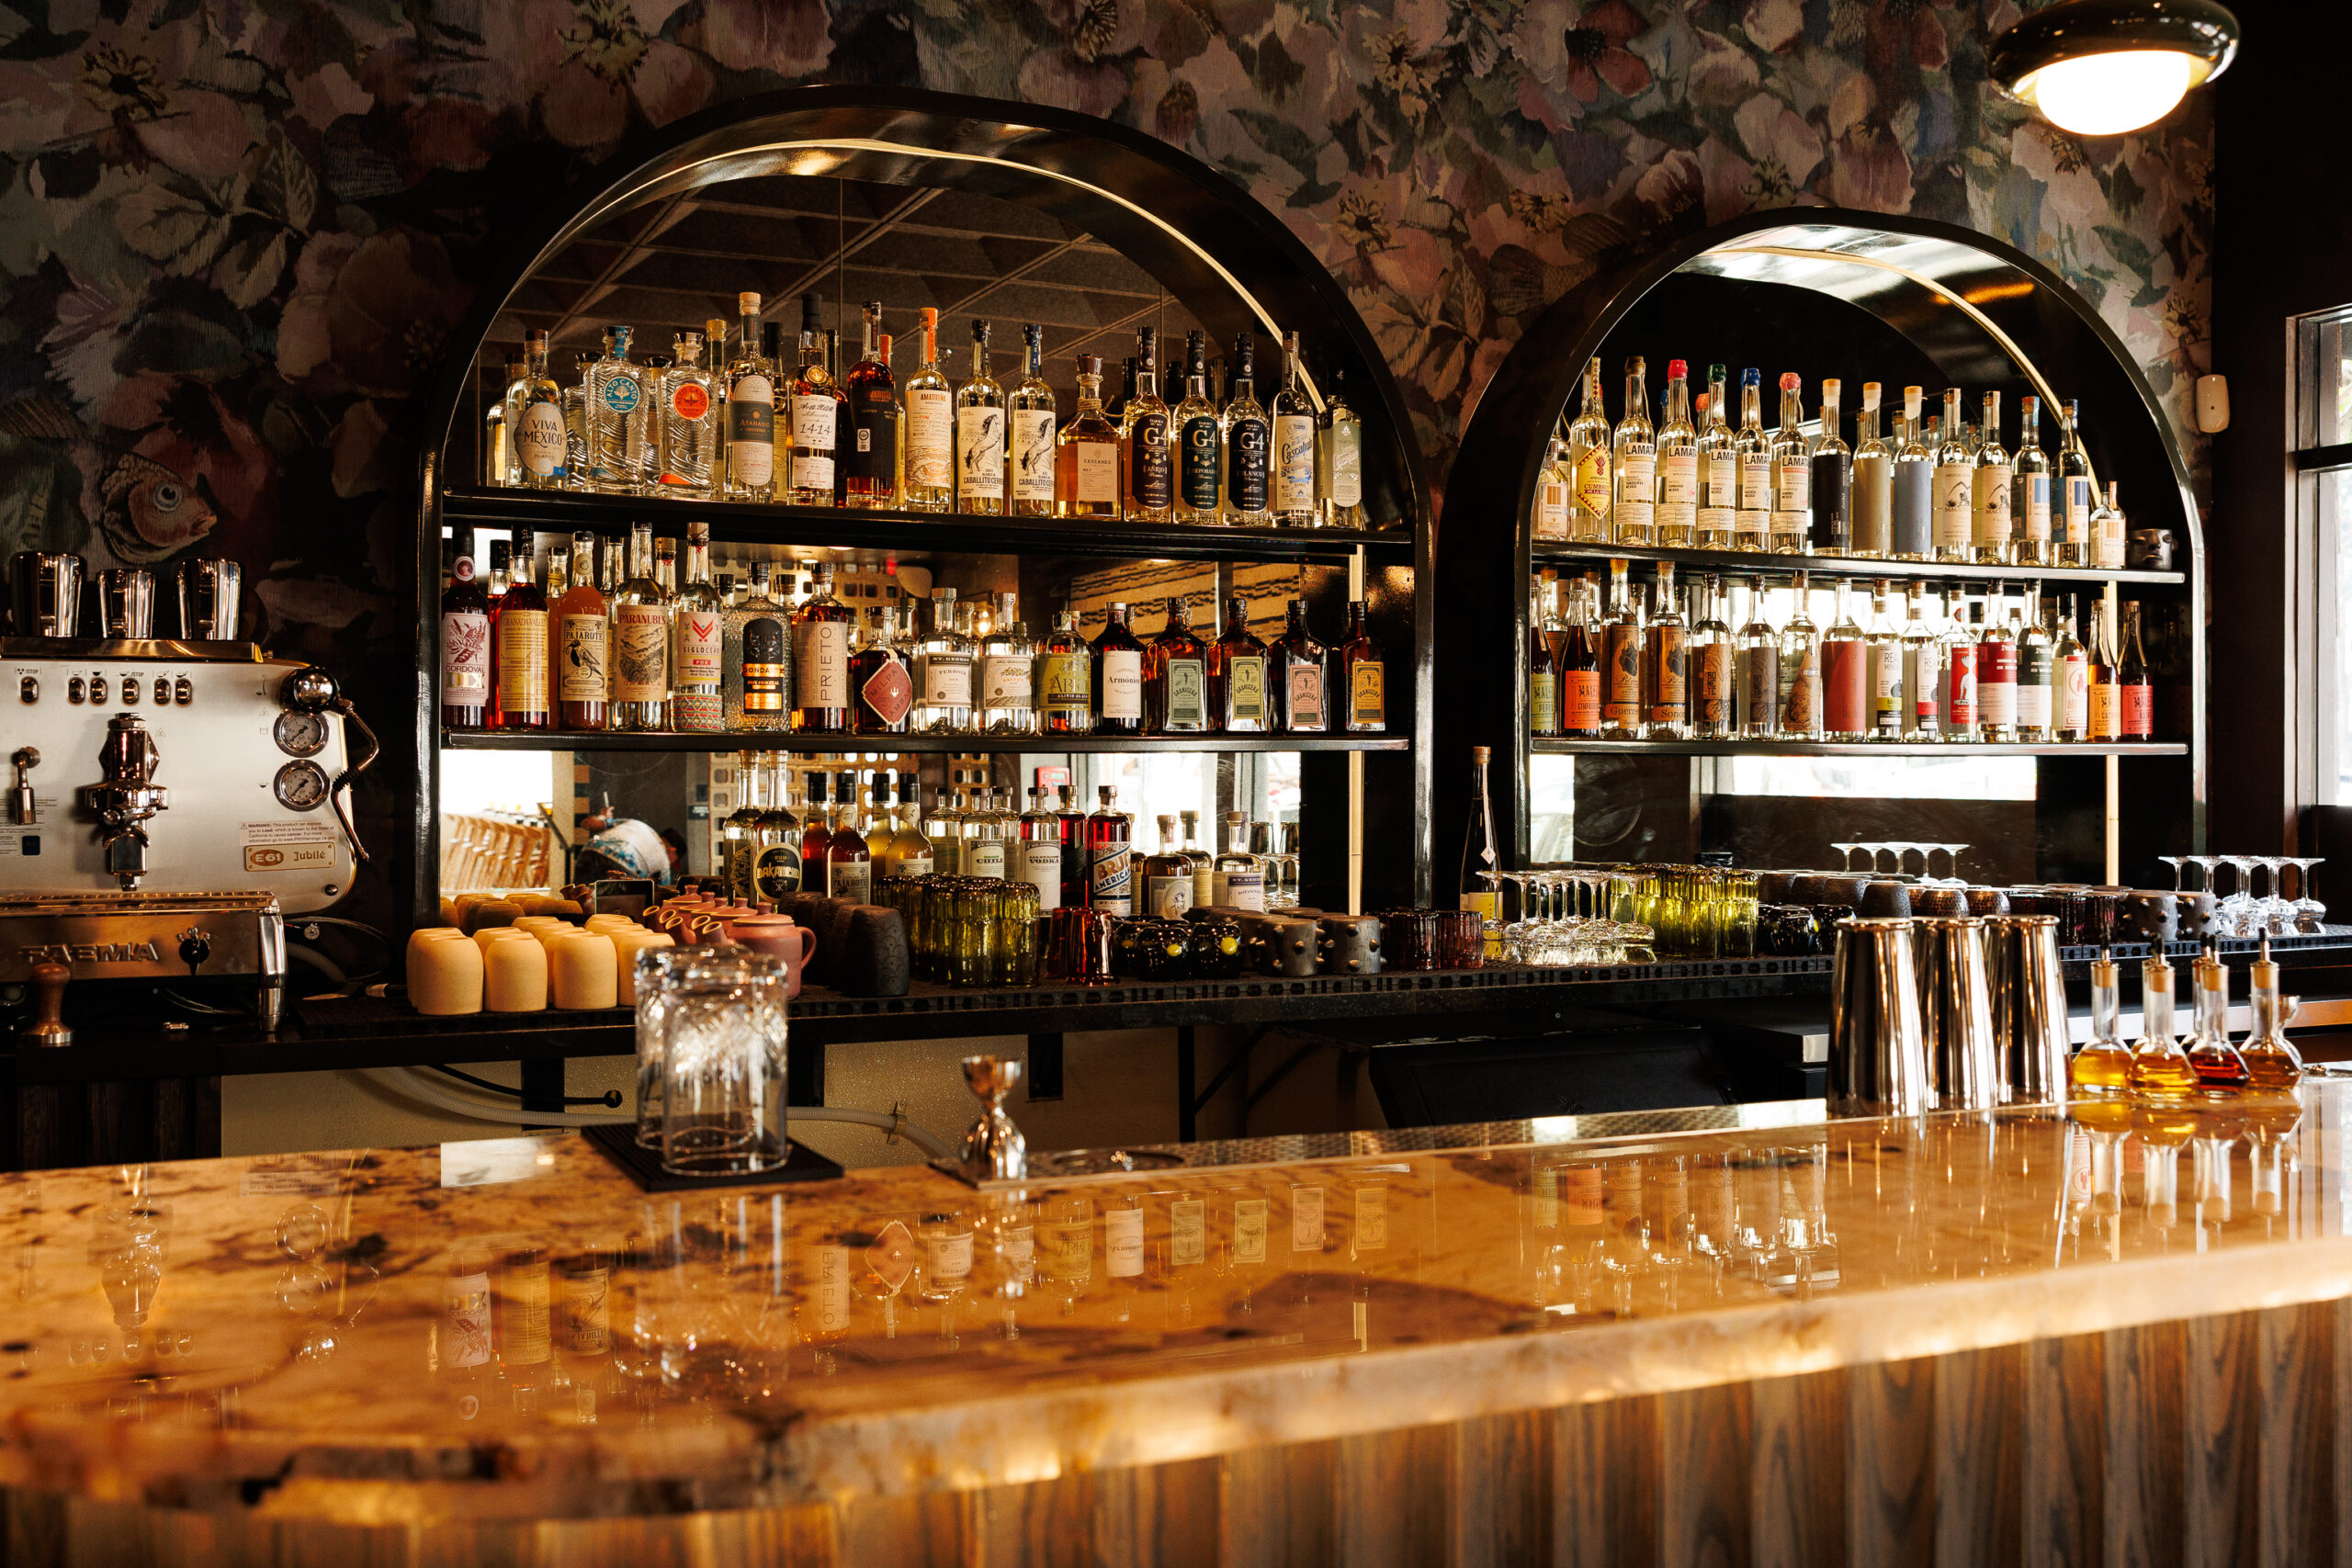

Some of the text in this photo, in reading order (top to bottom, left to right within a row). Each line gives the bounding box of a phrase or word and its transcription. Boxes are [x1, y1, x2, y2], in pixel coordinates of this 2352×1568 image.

[606, 378, 637, 400] ALTO CANTO
[532, 419, 558, 432] VIVA
[799, 423, 831, 435] 1414
[1144, 427, 1169, 446] G4
[1193, 429, 1216, 448] G4
[1240, 432, 1265, 450] G4
[1625, 445, 1655, 456] LAMAT
[1668, 447, 1697, 458] LAMAT
[619, 614, 666, 625] PARANUBES
[565, 631, 604, 641] PAJAROTE
[820, 626, 832, 701] PRIETO
[447, 672, 485, 689] DIX
[869, 669, 898, 697] MILPA
[1174, 686, 1197, 697] GRANICERA
[1236, 683, 1259, 694] GRANICERA
[1357, 688, 1381, 698] GRANICERA
[1295, 692, 1317, 702] GRANICERA
[1611, 705, 1638, 716] Guerre
[293, 850, 326, 862] Jubilé
[21, 942, 160, 963] FAEMA
